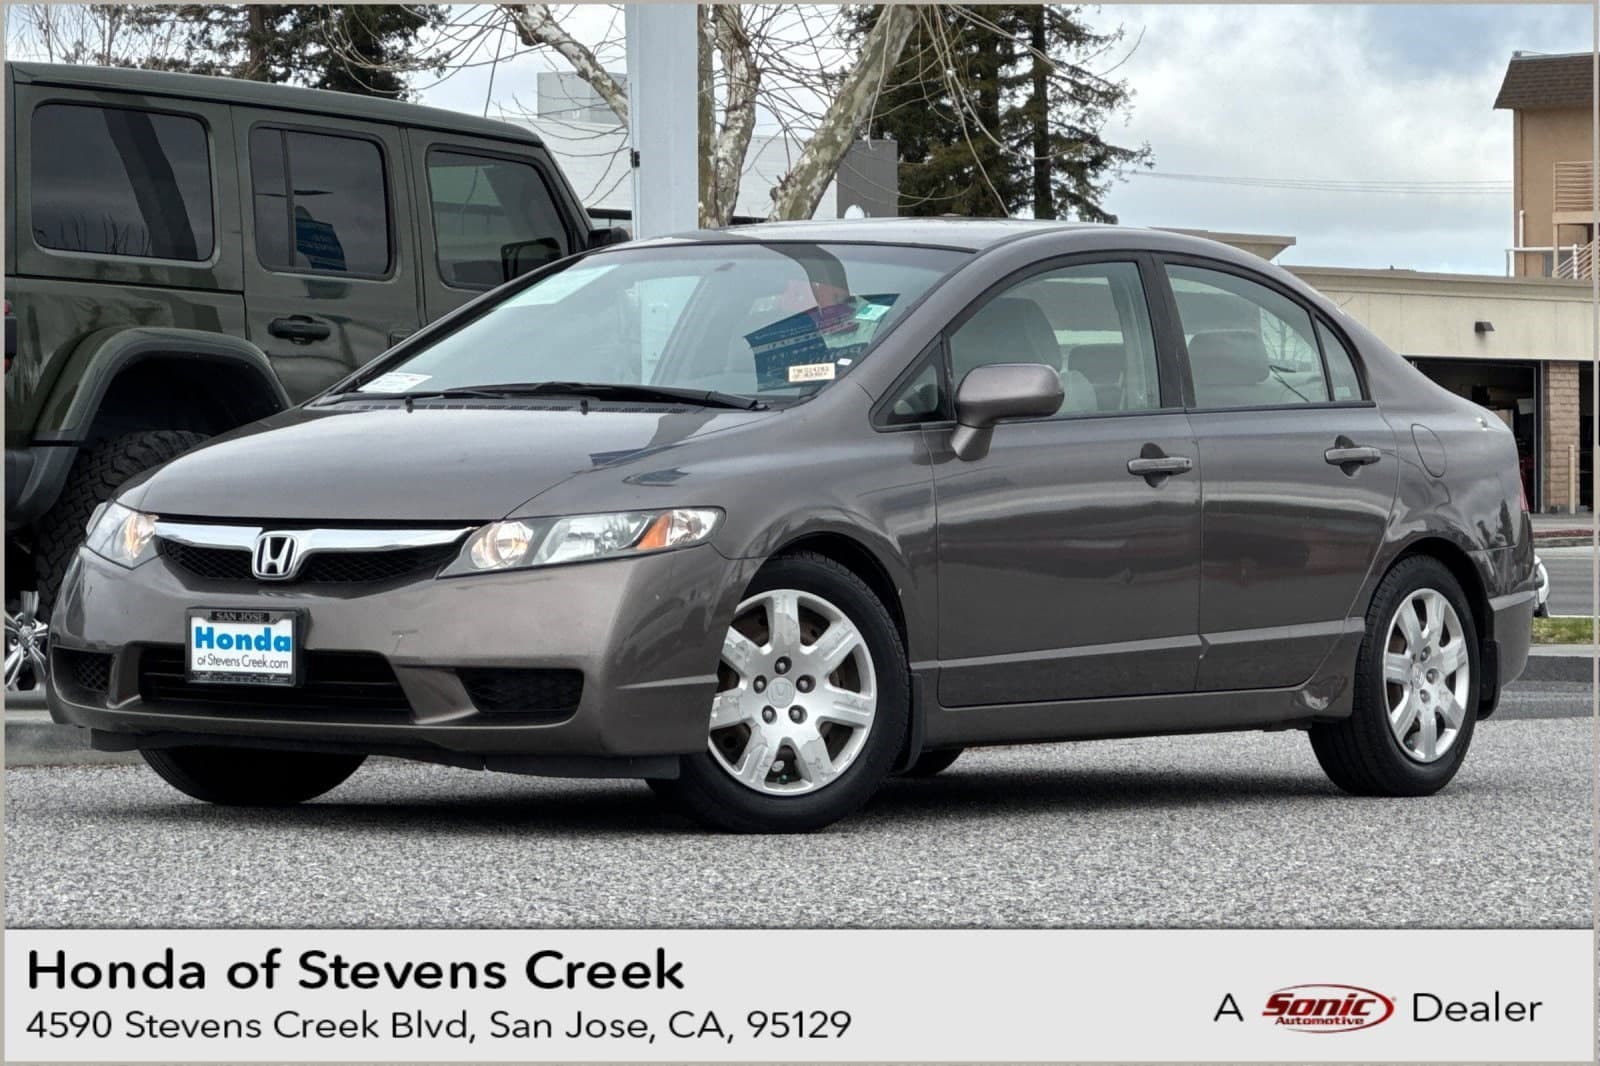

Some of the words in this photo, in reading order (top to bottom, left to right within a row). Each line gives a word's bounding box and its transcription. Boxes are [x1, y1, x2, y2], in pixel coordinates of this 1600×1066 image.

[216, 611, 236, 620] SAN
[239, 612, 265, 621] JOSE
[195, 626, 291, 652] Honda
